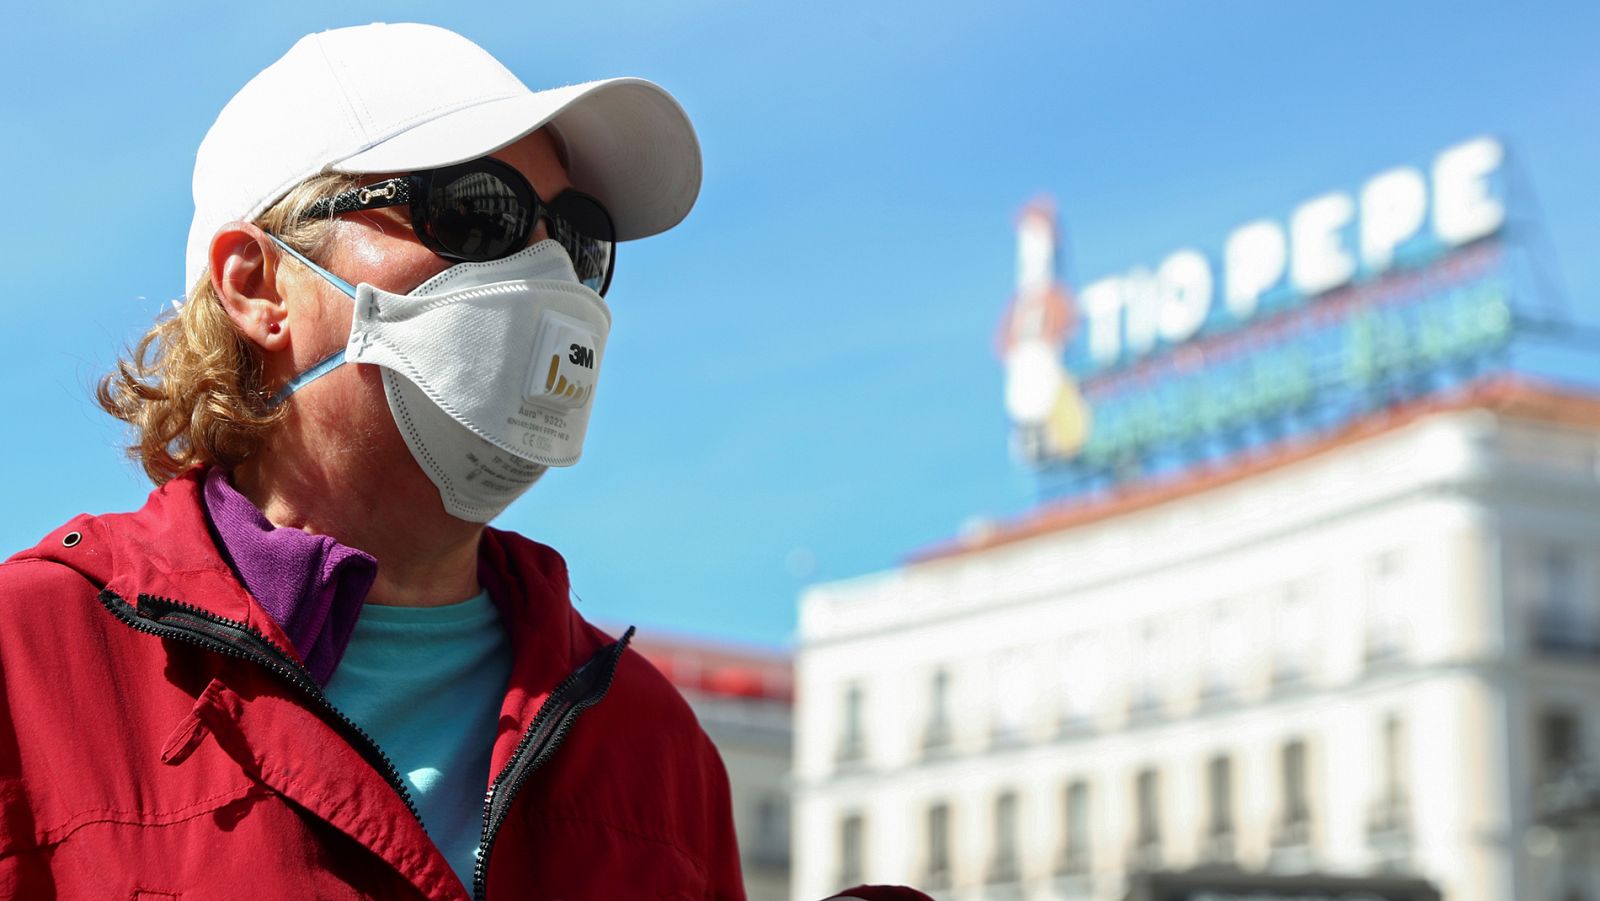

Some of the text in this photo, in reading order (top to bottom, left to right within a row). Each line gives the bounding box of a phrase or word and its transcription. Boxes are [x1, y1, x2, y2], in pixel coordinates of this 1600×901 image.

[1080, 136, 1505, 365] TIO PEPE
[569, 343, 594, 369] 3M
